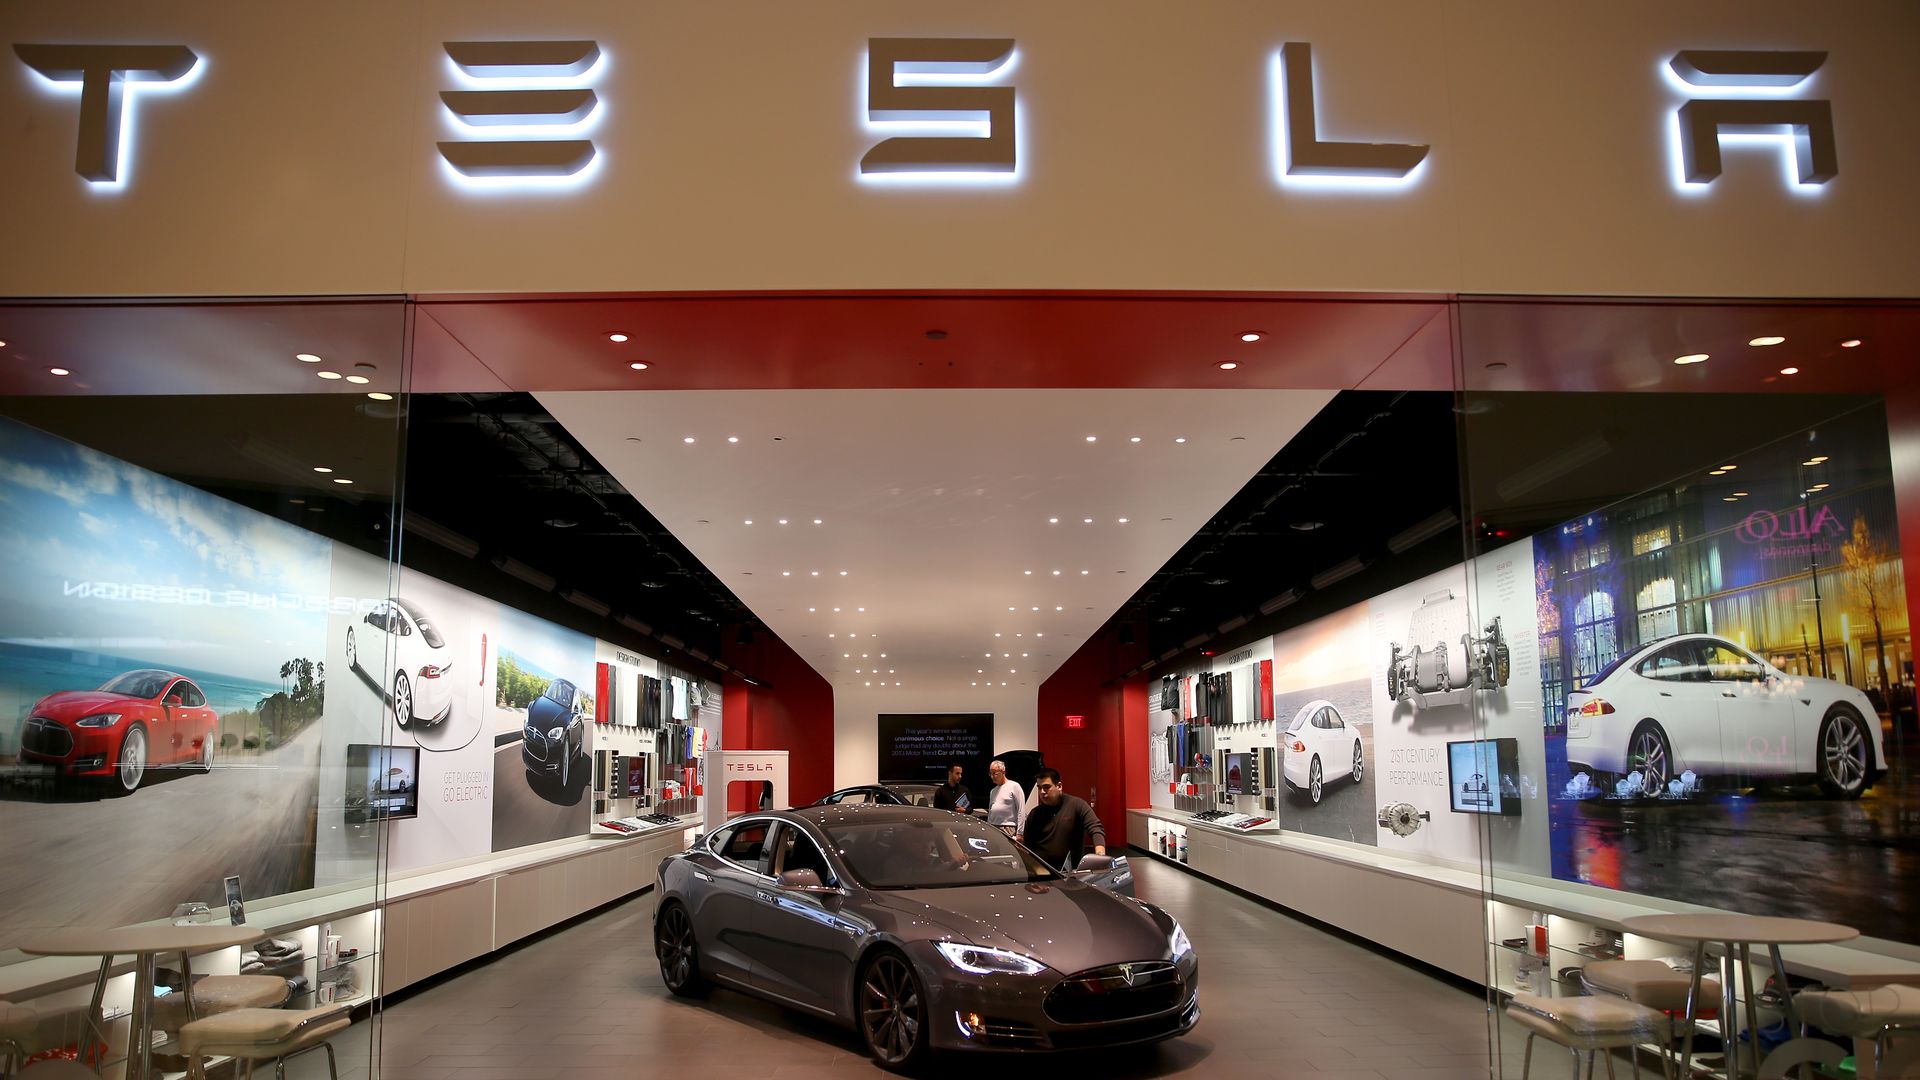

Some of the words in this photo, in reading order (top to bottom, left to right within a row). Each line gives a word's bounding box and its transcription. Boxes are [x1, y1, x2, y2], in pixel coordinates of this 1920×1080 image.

[12, 38, 1839, 188] TESLA
[1069, 718, 1081, 727] EXIT
[1406, 748, 1440, 763] CENTURY
[727, 763, 773, 771] TESLA
[444, 771, 456, 784] GET
[457, 771, 482, 783] PLUGGED
[1389, 770, 1444, 787] PERFORMANCE
[444, 787, 454, 802] GO
[456, 785, 488, 801] ELECTRIC
